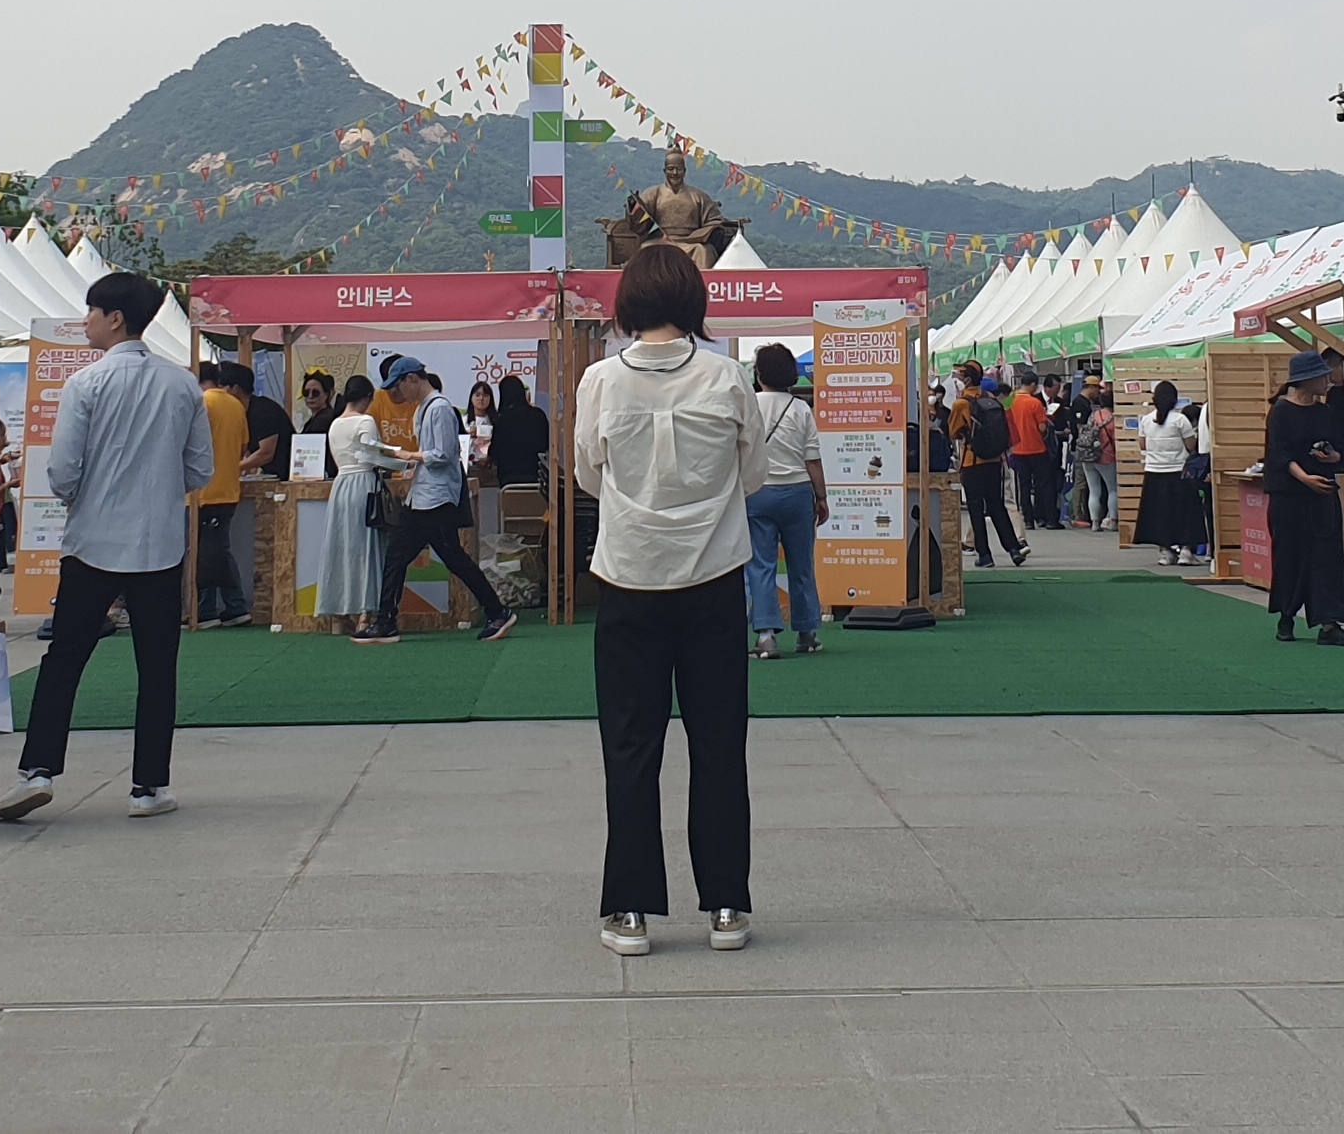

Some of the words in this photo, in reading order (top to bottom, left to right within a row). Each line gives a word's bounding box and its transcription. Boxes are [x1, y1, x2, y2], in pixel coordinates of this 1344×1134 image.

[336, 286, 413, 308] 안내부스
[707, 280, 784, 304] 안내부스
[820, 333, 858, 349] 스탬프
[859, 331, 897, 348] 모아서
[35, 349, 76, 365] 스탬프
[77, 348, 105, 364] 모아
[846, 348, 901, 365] 받아가자!
